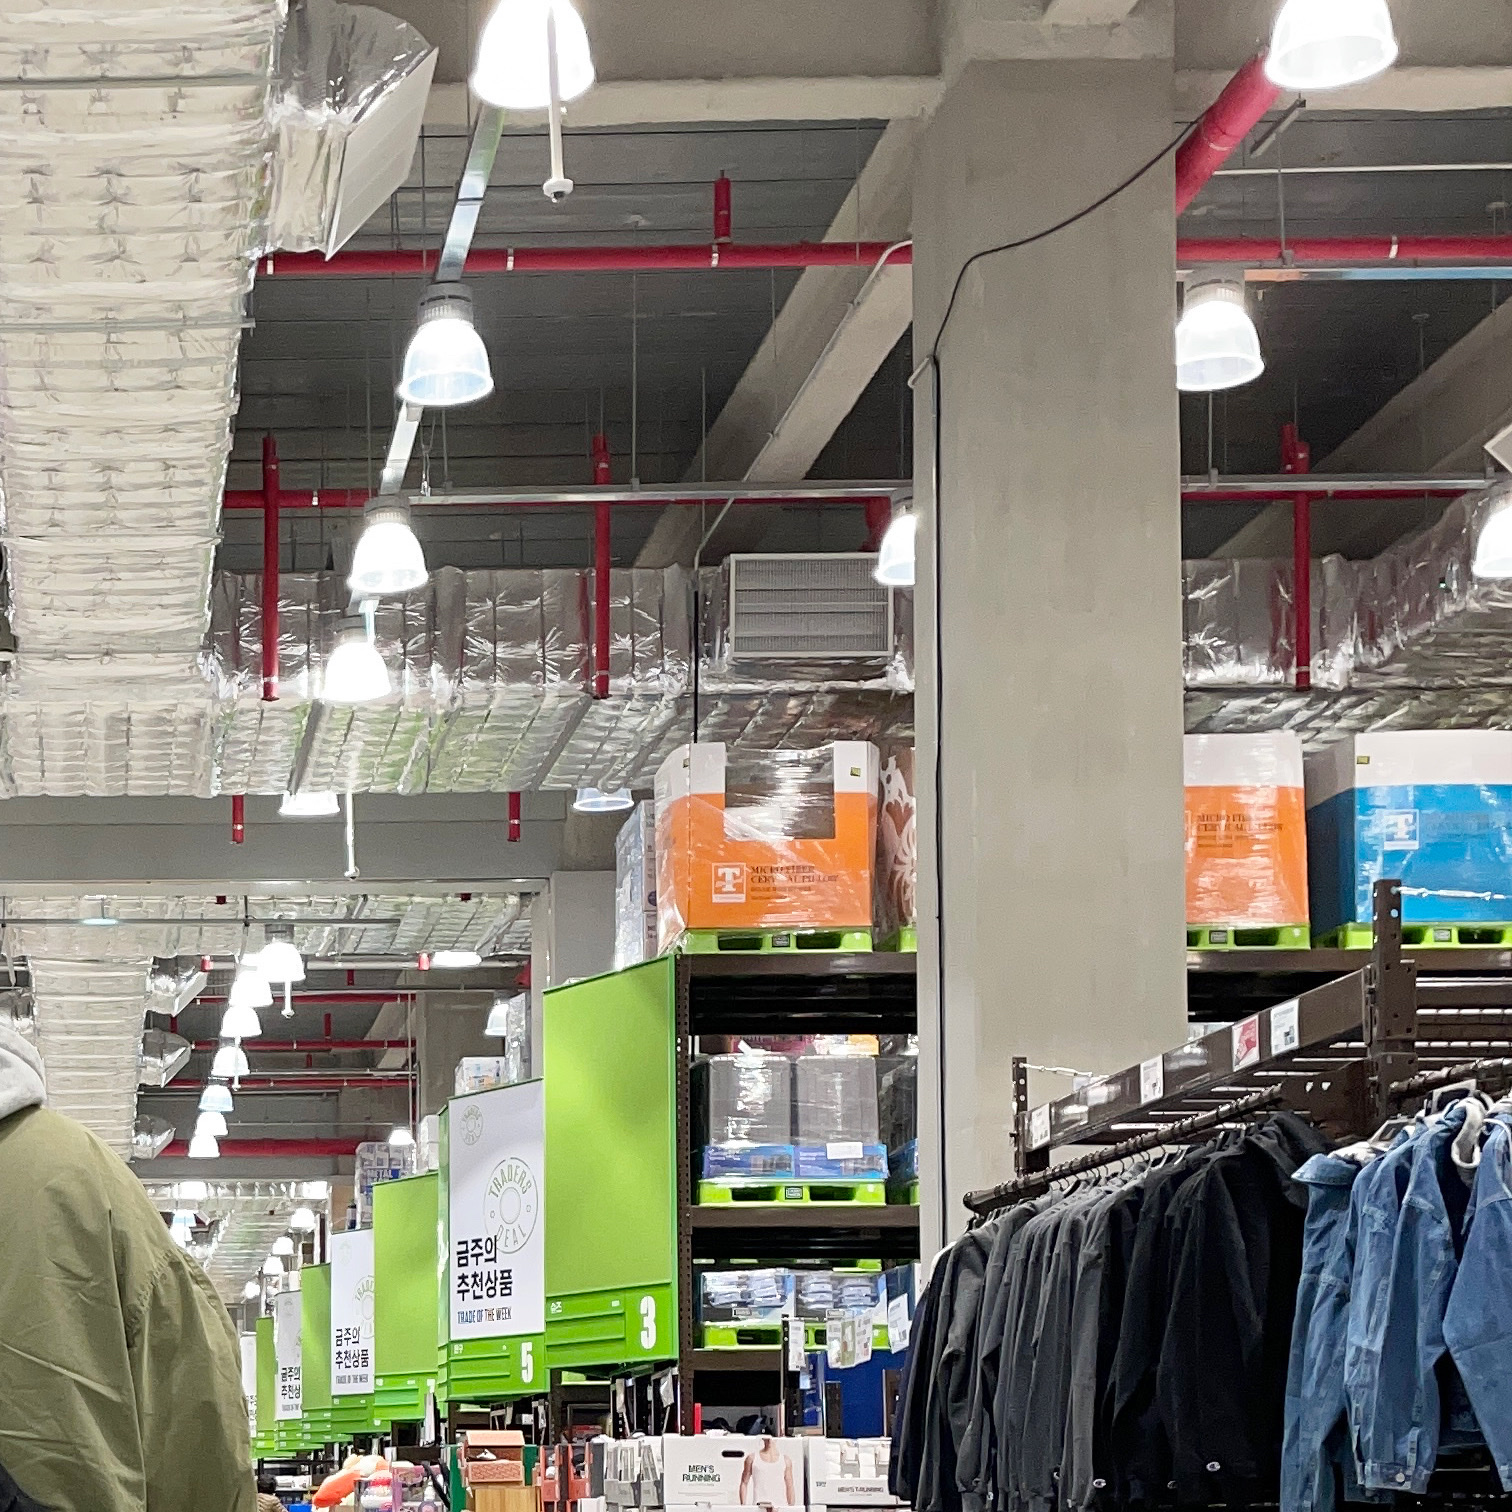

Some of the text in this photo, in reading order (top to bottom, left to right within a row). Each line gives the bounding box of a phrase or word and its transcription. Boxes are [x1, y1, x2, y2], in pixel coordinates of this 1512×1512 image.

[488, 1164, 532, 1198] TRADERS
[496, 1225, 527, 1248] DEAL
[456, 1234, 497, 1268] 금주의
[456, 1268, 513, 1302] 추천상품
[457, 1306, 512, 1324] TRADE OF THE WEEK
[640, 1295, 657, 1350] 3
[336, 1326, 361, 1347] 금주의
[335, 1349, 369, 1369] 추천상품
[520, 1341, 534, 1384] 5
[281, 1366, 301, 1382] 금주의
[281, 1385, 301, 1400] 추천상
[682, 1474, 721, 1482] RUNNING
[688, 1464, 715, 1473] MEN'S
